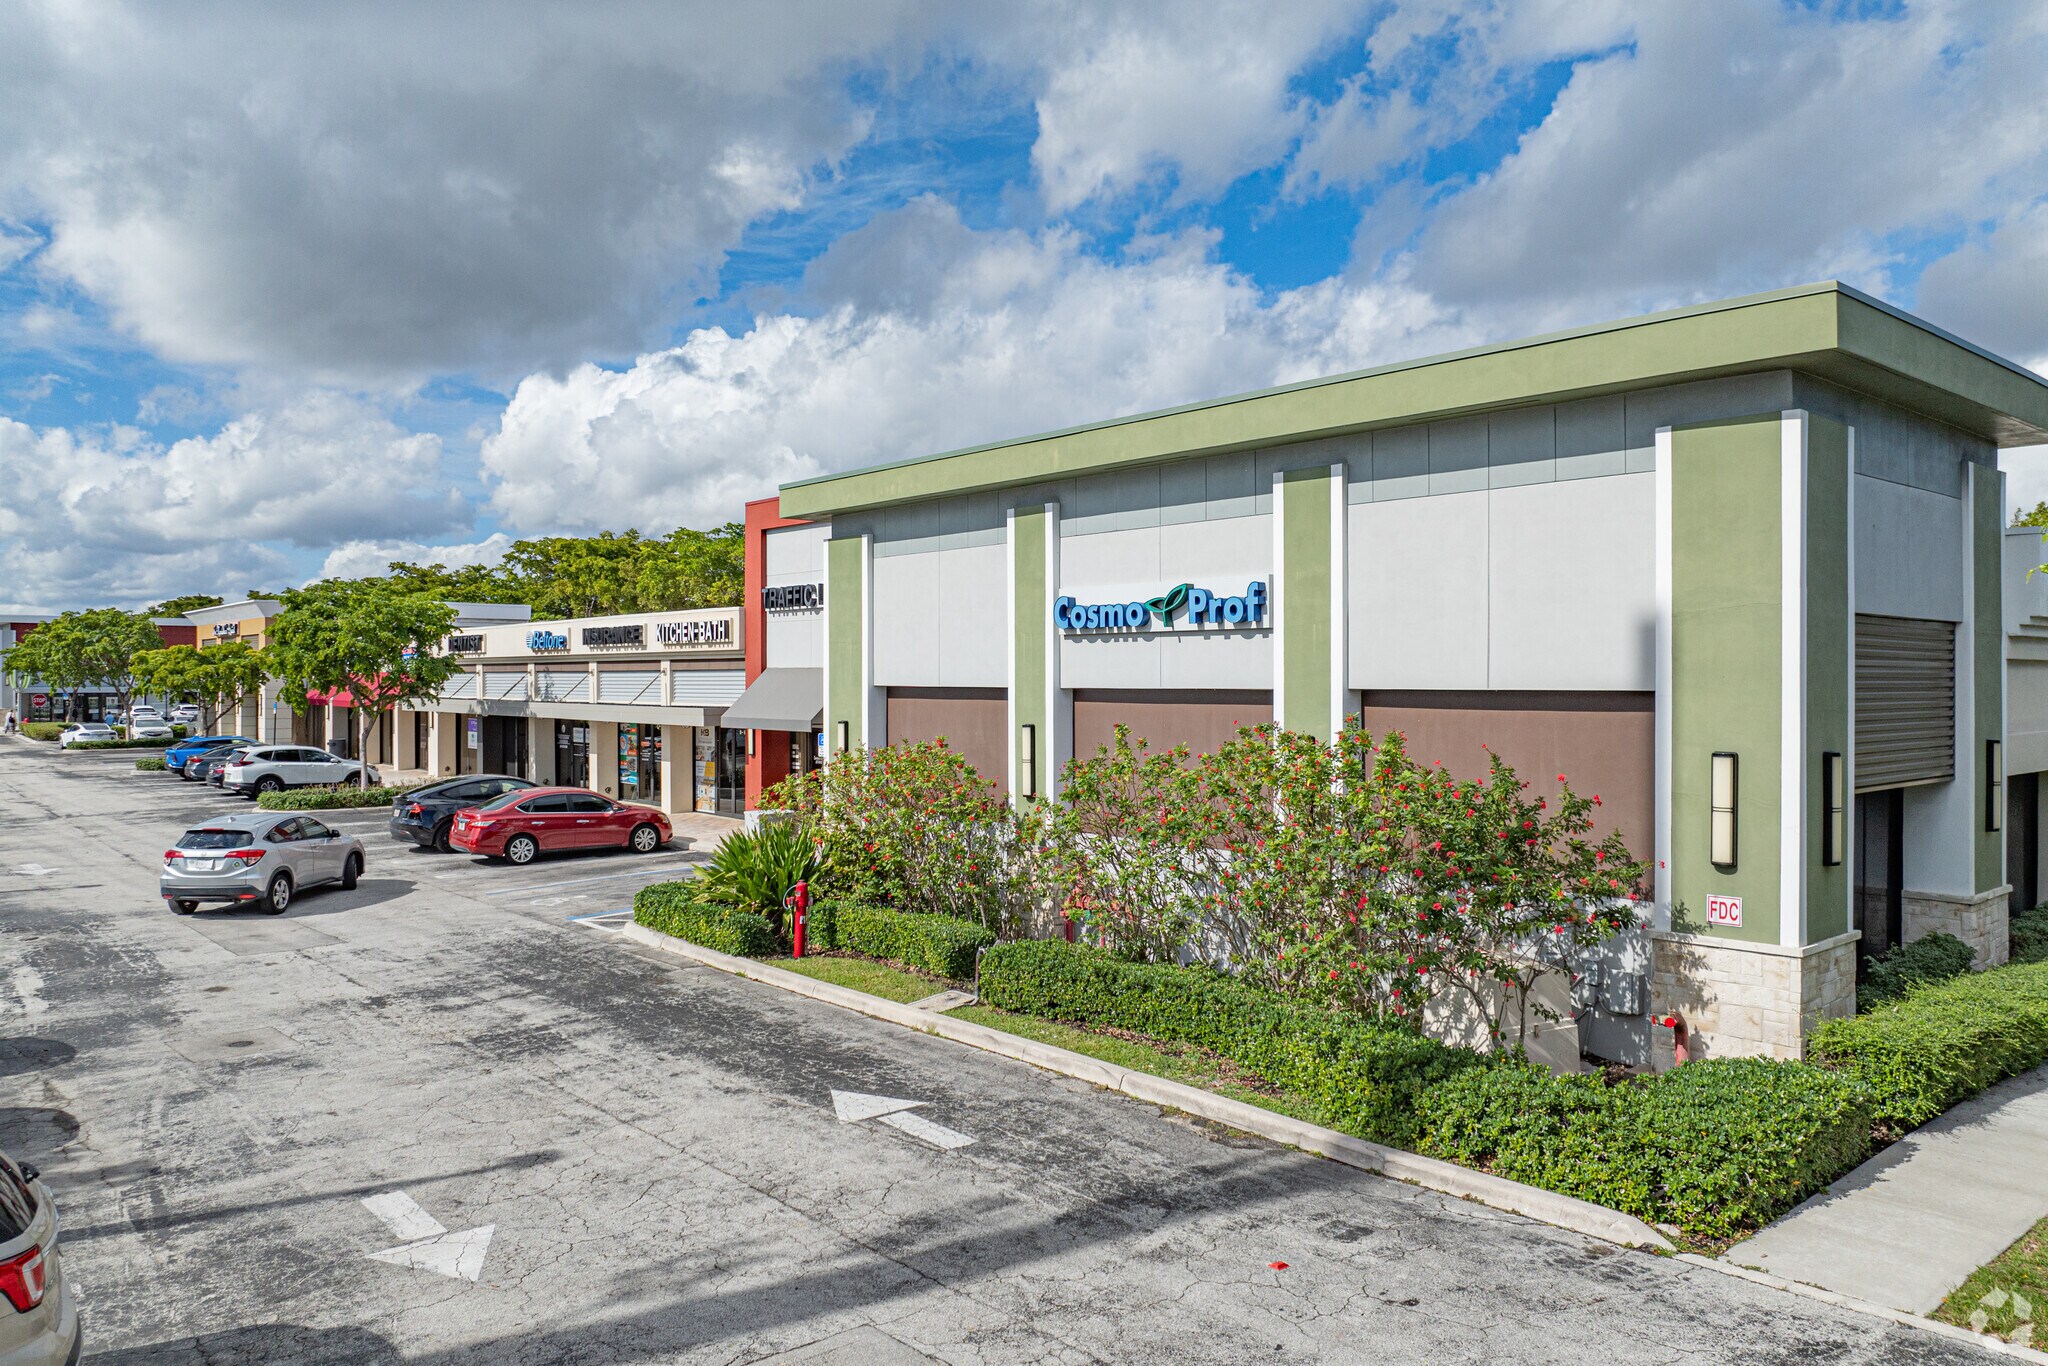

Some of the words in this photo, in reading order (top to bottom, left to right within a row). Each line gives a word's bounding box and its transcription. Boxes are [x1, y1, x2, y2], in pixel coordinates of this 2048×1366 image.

[762, 584, 817, 608] TRAFFIC
[1053, 596, 1148, 629] Cosmo
[1188, 581, 1265, 625] Prof
[533, 631, 567, 649] Beltone
[582, 625, 643, 645] INSURANCE
[656, 620, 728, 642] KITCHEN-BATH
[448, 634, 482, 652] DENTIST
[1710, 901, 1739, 921] FDC
